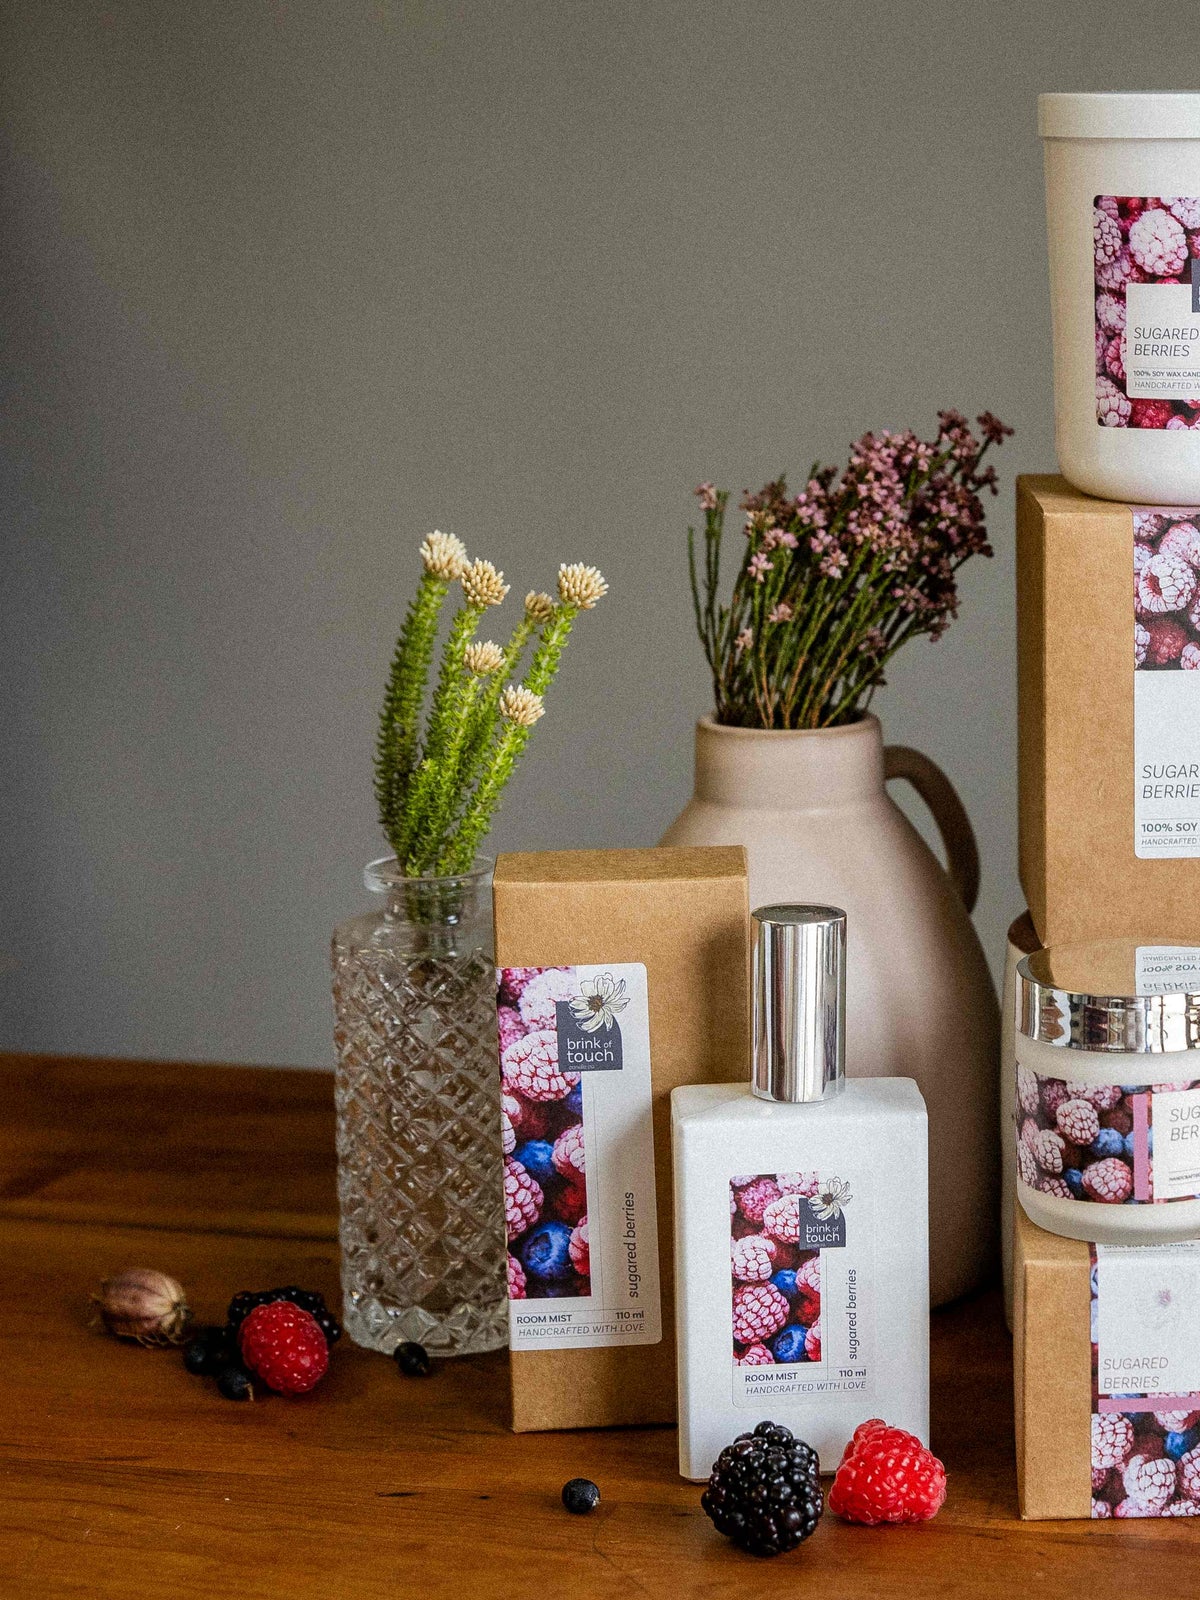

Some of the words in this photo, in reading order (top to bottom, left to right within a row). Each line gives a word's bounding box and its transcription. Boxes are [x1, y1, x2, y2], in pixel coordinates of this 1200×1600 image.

[1133, 327, 1200, 340] SUGARED
[1133, 344, 1190, 357] BERRIES
[1134, 381, 1192, 390] HANDCRAFTED
[1141, 823, 1173, 833] 100%
[1176, 822, 1198, 832] SOY
[1141, 838, 1198, 846] HANDCRAFTED
[567, 1036, 602, 1050] brink
[604, 1040, 612, 1048] of
[566, 1049, 614, 1062] touch
[622, 1192, 636, 1239] berries
[806, 1223, 831, 1233] brink
[806, 1232, 840, 1242] touch
[624, 1242, 642, 1298] sugared
[846, 1269, 856, 1310] berries
[516, 1314, 549, 1324] ROOM
[550, 1314, 572, 1323] MIST
[615, 1311, 630, 1320] 110
[631, 1310, 644, 1318] ml
[518, 1325, 590, 1337] HANDCRAFTED
[592, 1324, 618, 1334] WITH
[620, 1323, 645, 1332] LOVE
[846, 1312, 860, 1360] sugared
[1103, 1357, 1168, 1370] SUGARED
[744, 1373, 774, 1382] ROOM
[776, 1372, 798, 1381] MIST
[839, 1370, 853, 1378] 110
[855, 1368, 867, 1376] ml
[746, 1384, 814, 1395] HANDCRAFTED
[816, 1382, 841, 1391] WITH
[842, 1381, 866, 1390] LOVE
[1103, 1376, 1160, 1389] BERRIES
